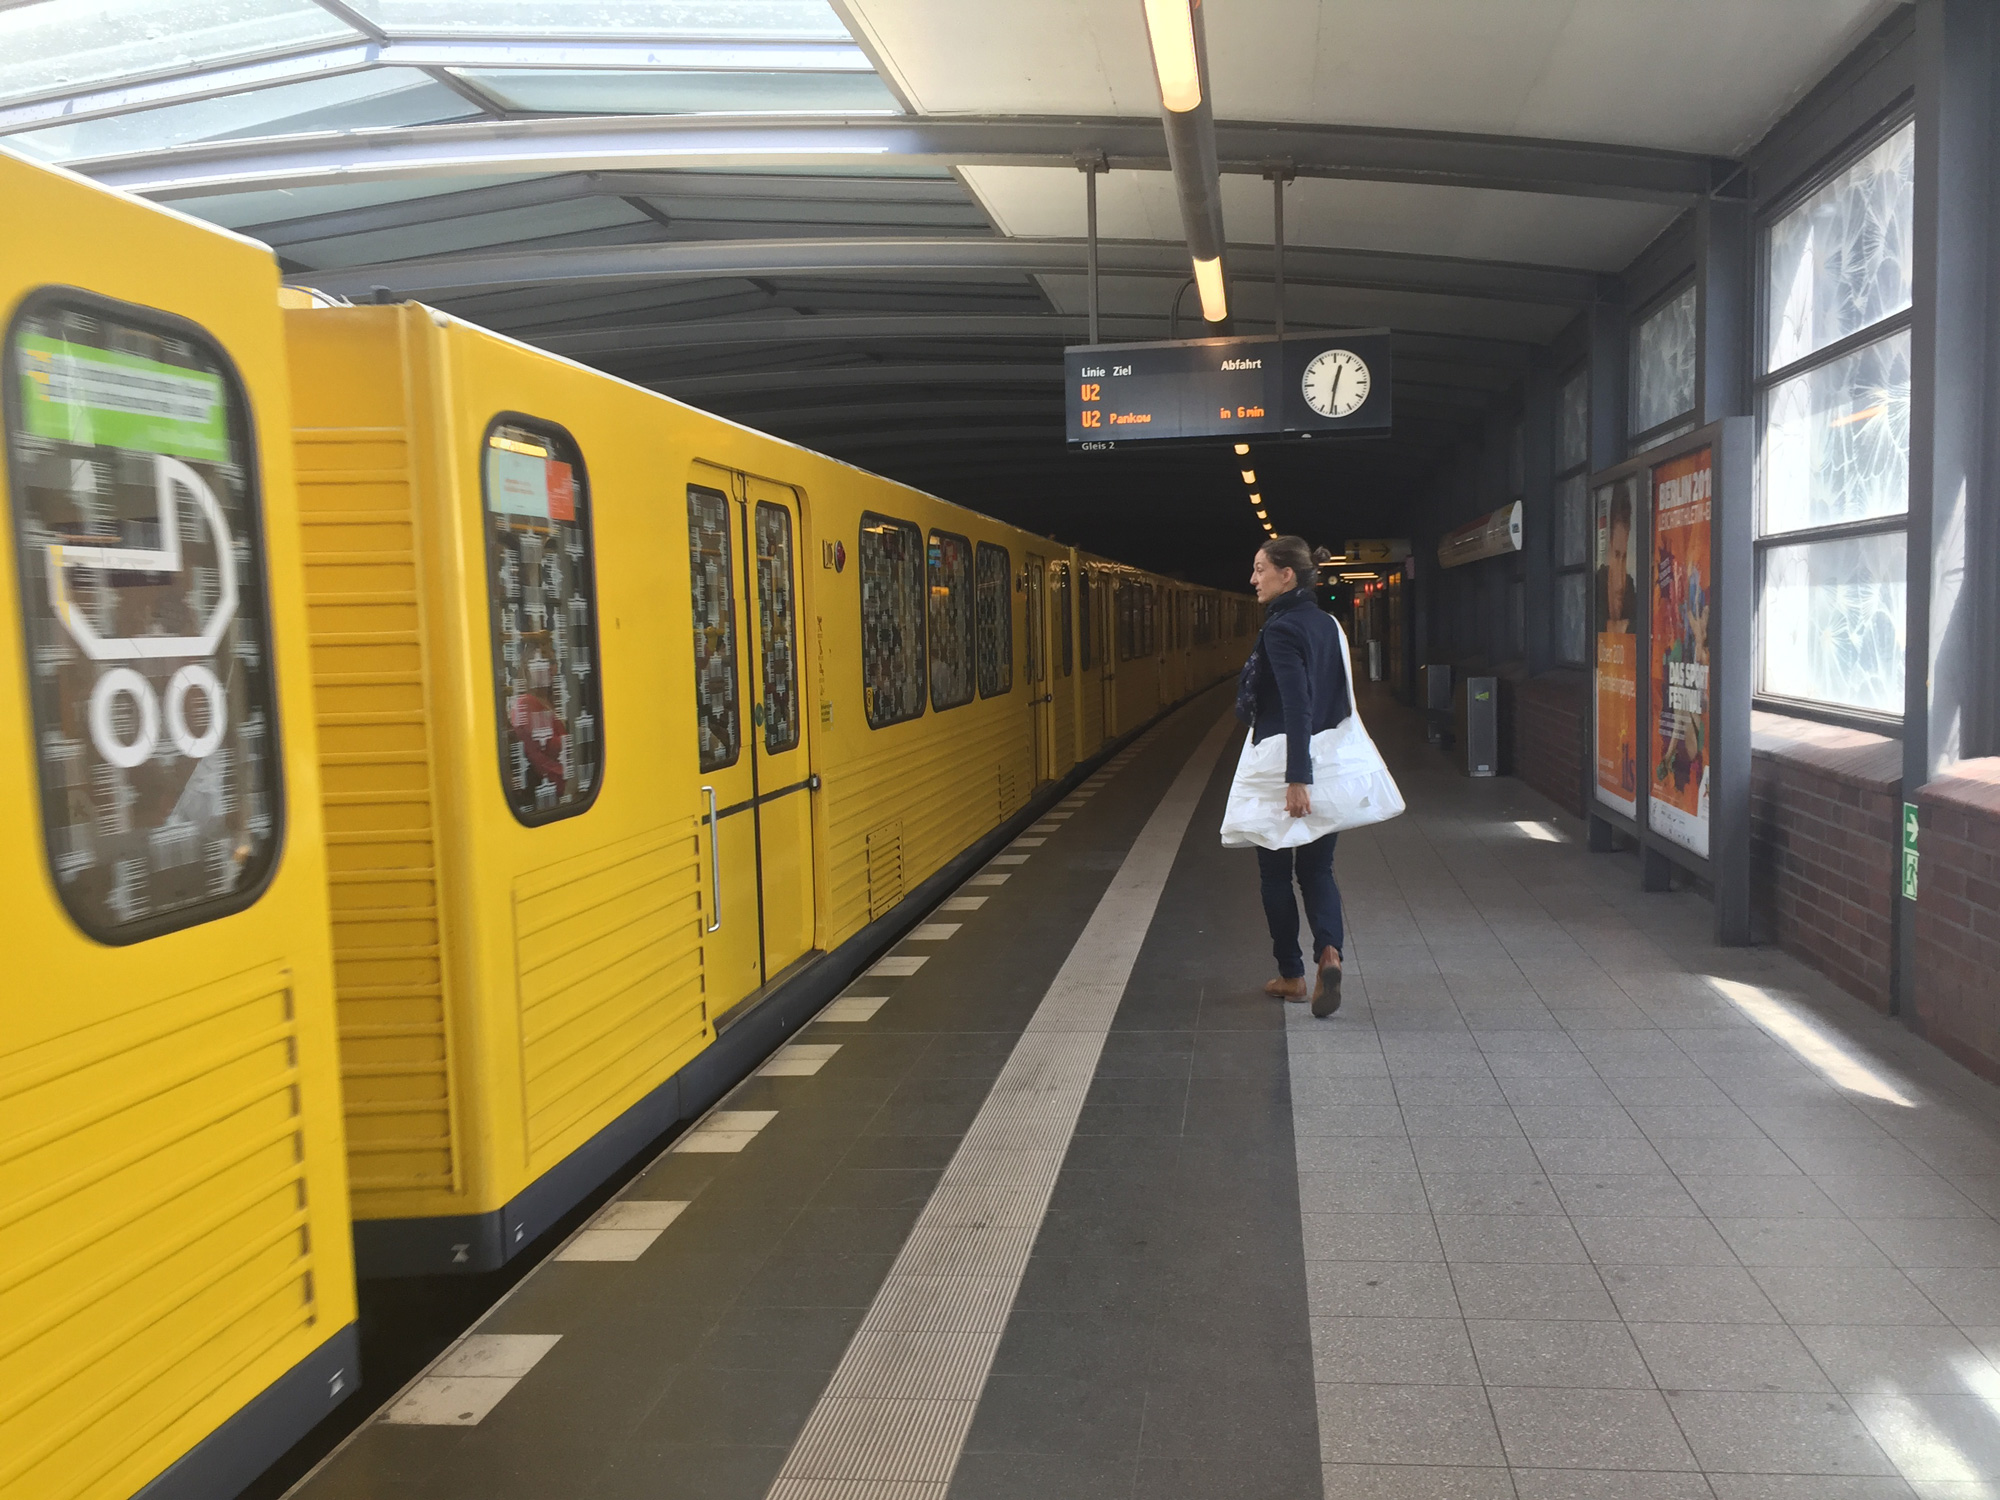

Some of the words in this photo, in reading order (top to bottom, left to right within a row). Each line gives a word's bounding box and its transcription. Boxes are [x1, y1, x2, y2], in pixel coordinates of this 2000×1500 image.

[1081, 366, 1106, 378] Linie
[1112, 364, 1132, 377] Ziel
[1221, 358, 1262, 371] Abfahrt
[1081, 383, 1101, 402] U2
[1081, 410, 1101, 428] U2
[1109, 412, 1152, 425] Pankow
[1220, 407, 1231, 419] in
[1237, 406, 1246, 418] 6
[1246, 405, 1265, 418] min
[1081, 442, 1106, 451] Gleis
[1108, 441, 1115, 450] 2
[1659, 473, 1692, 511] BERLIN
[1668, 661, 1684, 686] DAS
[1668, 686, 1702, 715] FESTIVAL
